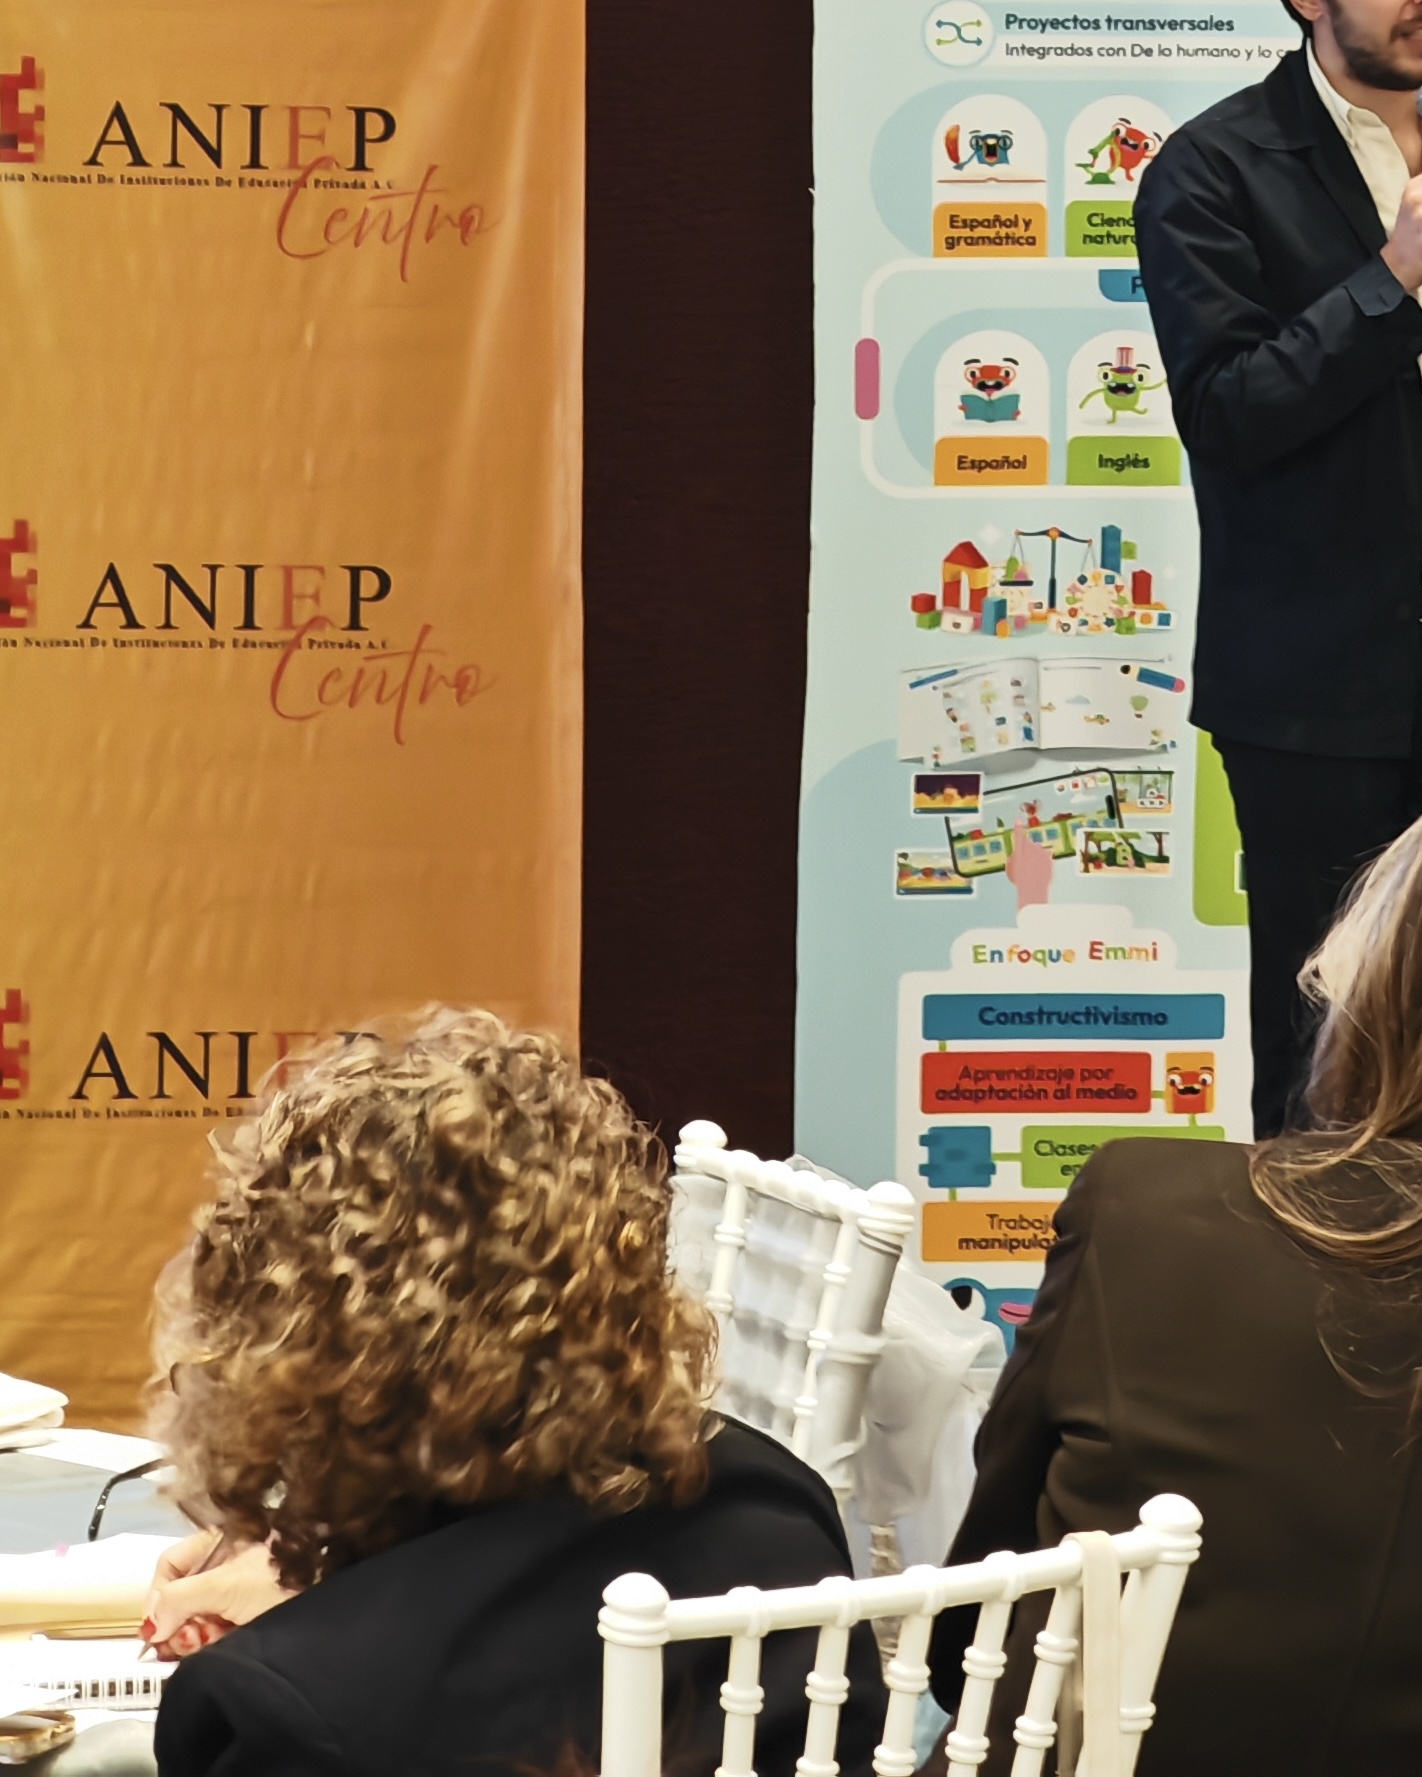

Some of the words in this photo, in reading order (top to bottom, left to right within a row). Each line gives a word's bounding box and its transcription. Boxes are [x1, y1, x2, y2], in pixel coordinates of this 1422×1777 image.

[1005, 14, 1101, 35] Proyectos
[1105, 15, 1235, 33] transversales
[1005, 42, 1093, 60] Integrados
[1097, 46, 1127, 58] con
[1131, 44, 1153, 58] De
[1157, 44, 1172, 58] lo
[1177, 45, 1241, 59] humano
[1244, 49, 1254, 62] y
[1257, 44, 1273, 59] lo
[82, 99, 397, 173] ANIEP
[32, 171, 93, 185] Nacional
[238, 176, 308, 190] Educacin
[277, 155, 500, 283] Centro
[949, 214, 1020, 233] Español
[1022, 215, 1033, 233] y
[1086, 212, 1136, 228] Cienc
[944, 232, 1038, 251] gramática
[956, 455, 1028, 473] Español
[1097, 454, 1151, 473] Inglés
[76, 561, 393, 632] ANIEP
[232, 638, 302, 651] Educacin
[270, 615, 497, 746] Centro
[971, 943, 1077, 968] Enfoque
[1088, 940, 1160, 962] Emmi
[977, 1005, 1170, 1028] Constructivismo
[69, 1031, 384, 1101] ANIE
[958, 1064, 1076, 1085] Aprendizaje
[1080, 1066, 1115, 1085] por
[935, 1084, 1051, 1103] adaptación
[1053, 1084, 1072, 1102] al
[1075, 1085, 1138, 1103] medio
[985, 1213, 1056, 1235] Trabaj
